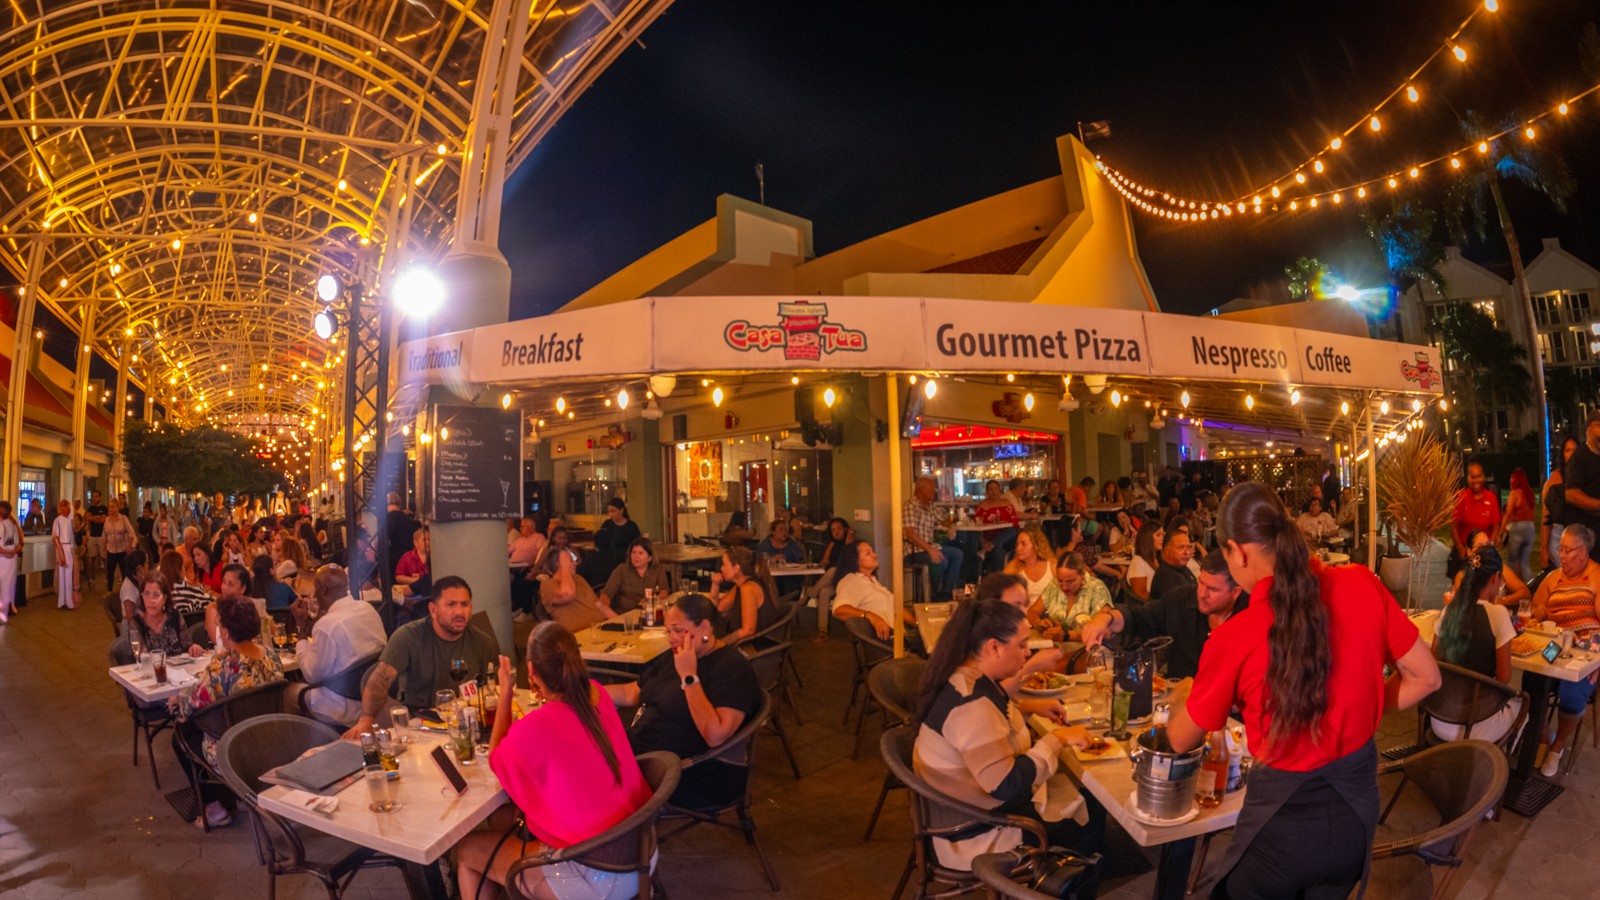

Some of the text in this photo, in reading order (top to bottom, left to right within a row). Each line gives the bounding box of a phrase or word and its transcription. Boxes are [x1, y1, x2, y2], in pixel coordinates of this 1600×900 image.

[408, 332, 584, 372] Traditional Breakfast
[727, 322, 865, 352] Casa Tua
[936, 323, 1141, 362] Gourmet Pizza
[1191, 335, 1352, 374] Nespresso Coffee
[464, 682, 476, 697] 48
